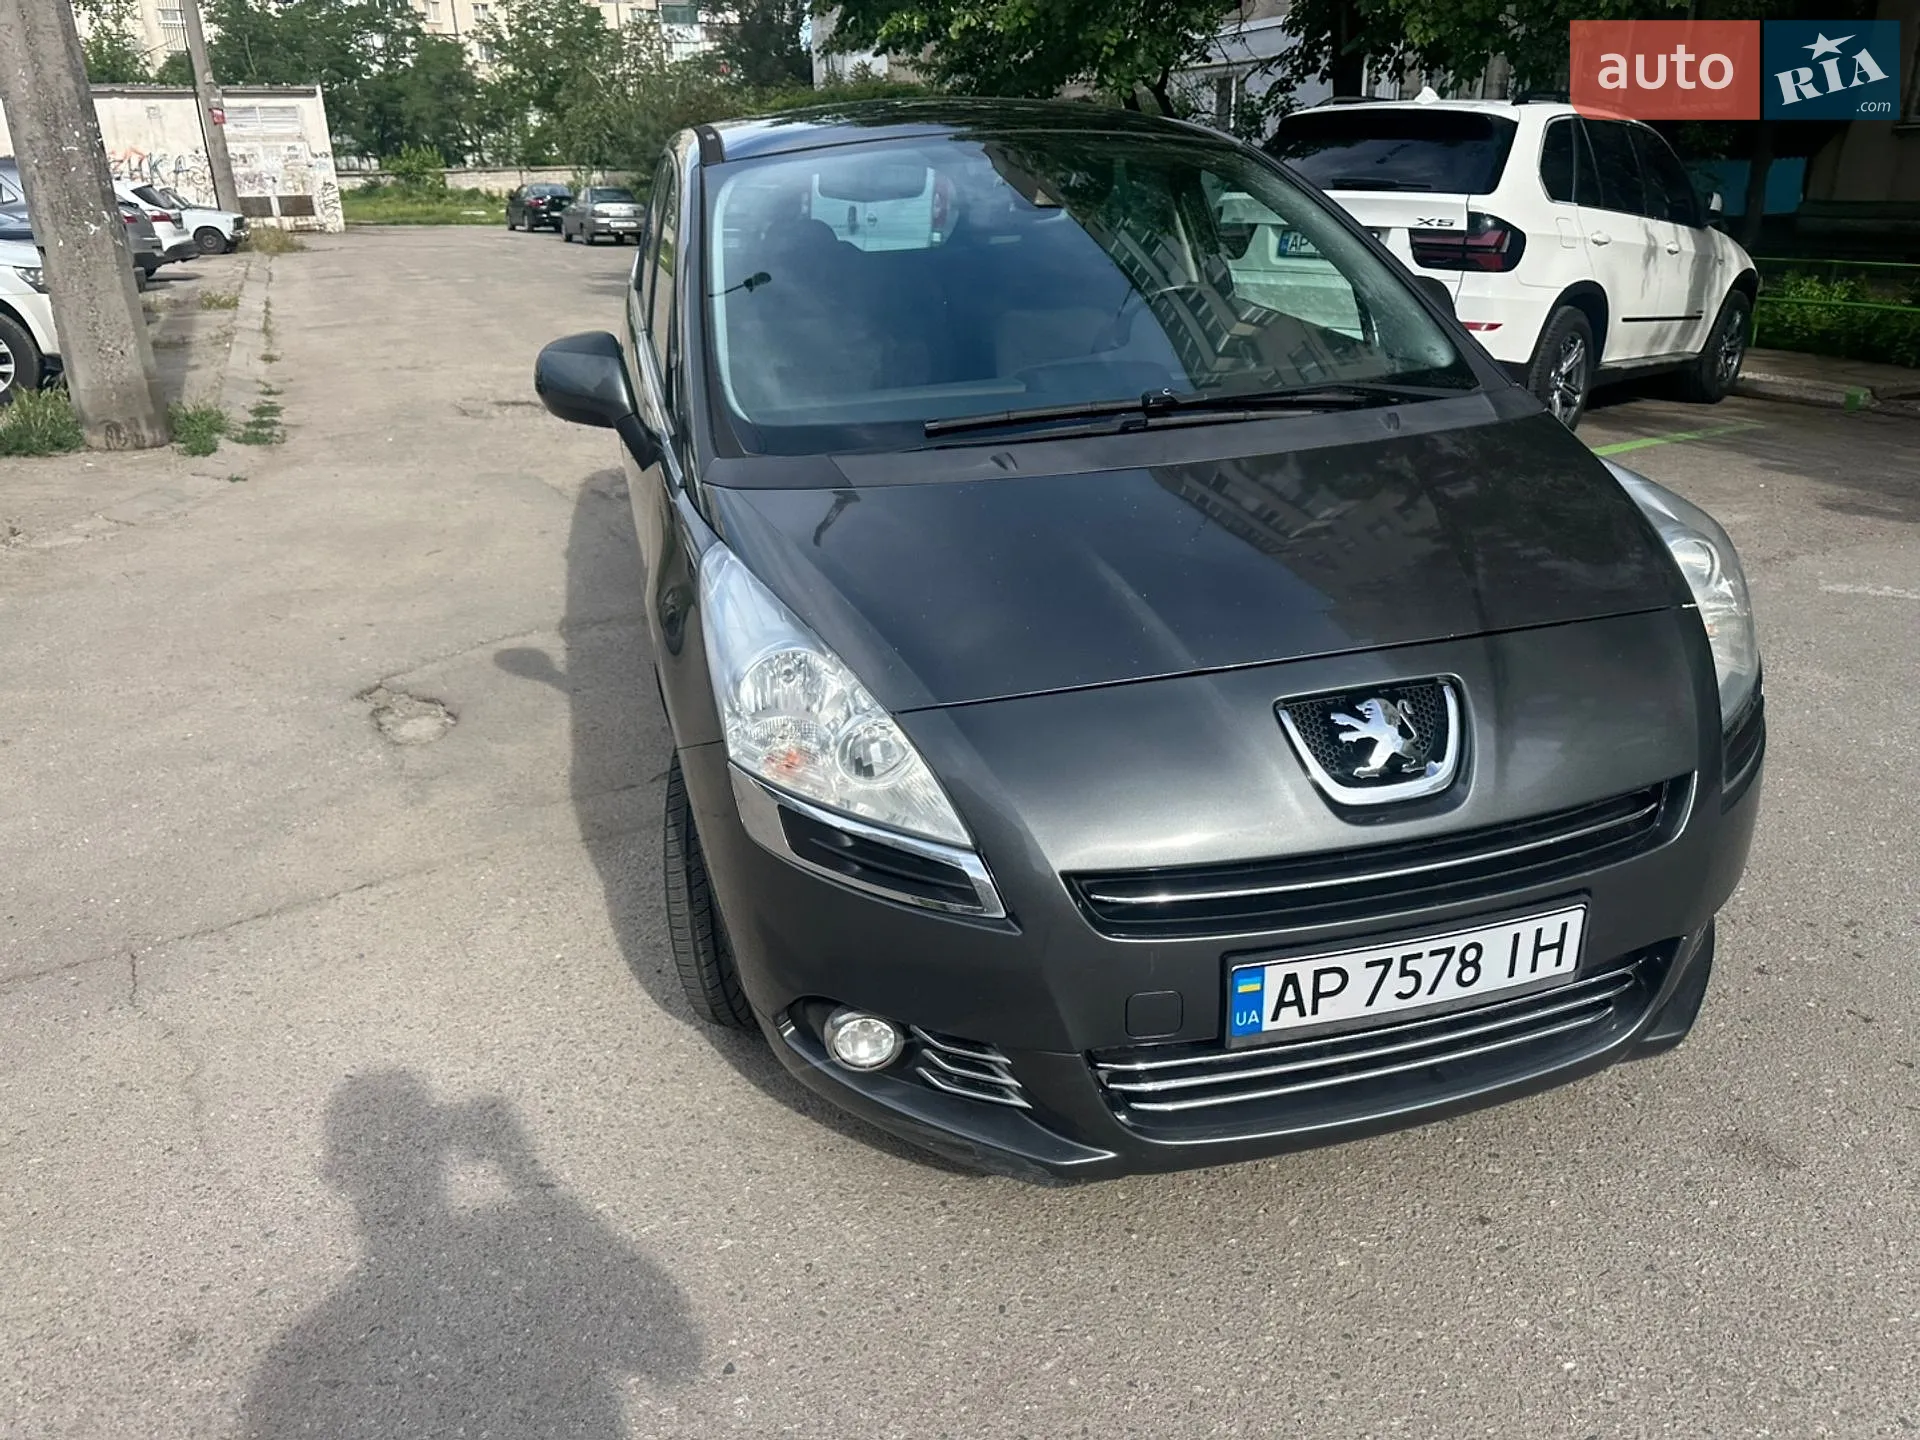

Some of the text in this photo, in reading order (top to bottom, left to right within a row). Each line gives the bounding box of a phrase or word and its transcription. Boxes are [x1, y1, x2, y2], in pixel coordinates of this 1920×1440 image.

[1413, 217, 1455, 227] X5
[1270, 921, 1568, 1022] AP 7578 IH
[1236, 1009, 1260, 1026] UA
